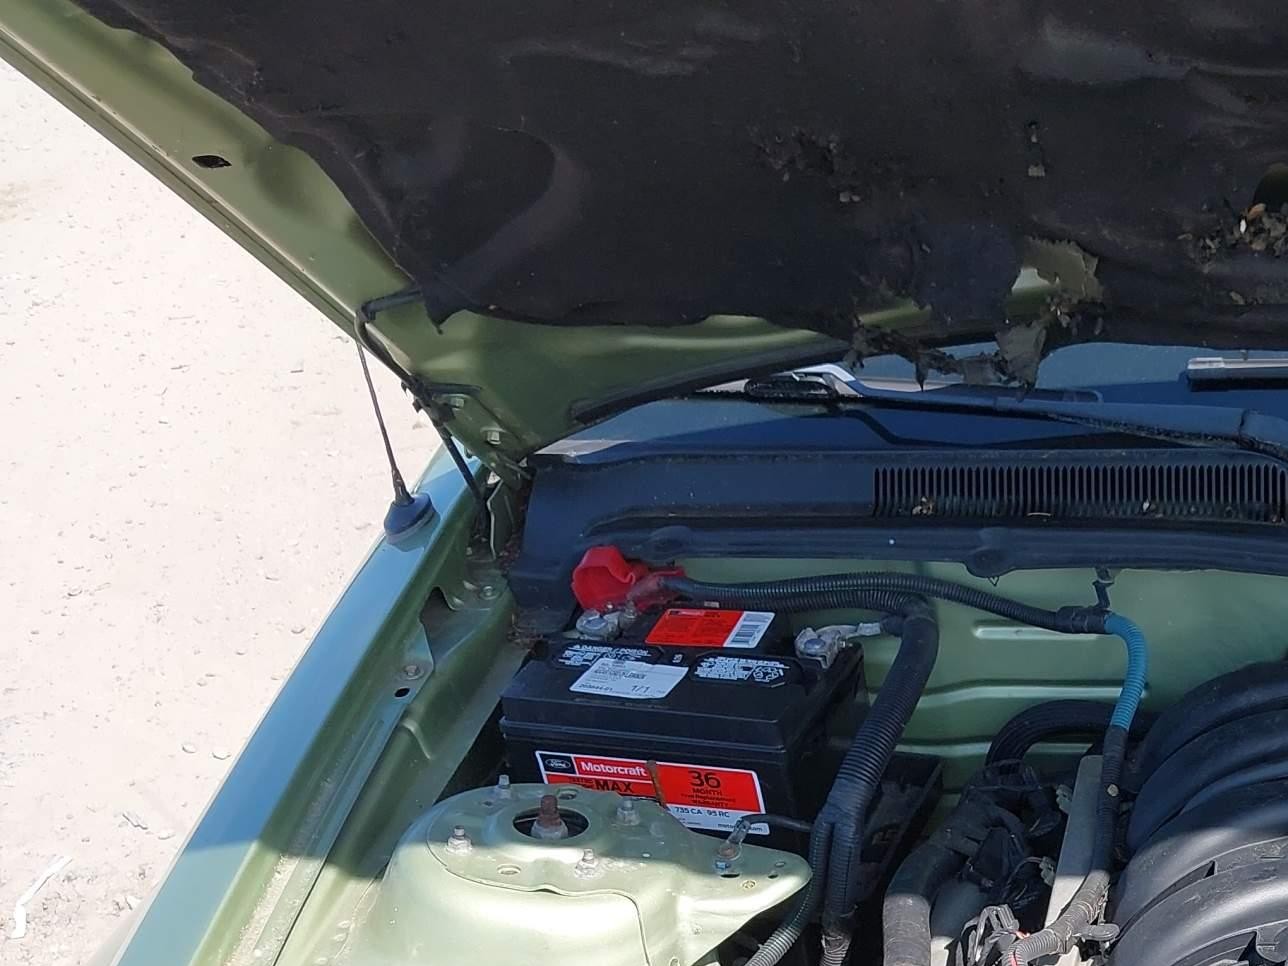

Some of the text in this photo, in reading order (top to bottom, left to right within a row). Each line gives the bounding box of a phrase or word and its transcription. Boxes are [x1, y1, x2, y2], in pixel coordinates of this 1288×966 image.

[580, 761, 648, 777] Motorcraft
[595, 779, 635, 794] MAX
[688, 771, 721, 789] 36
[691, 788, 723, 797] MONTH
[675, 806, 690, 815] 735
[690, 808, 703, 816] CA
[718, 810, 730, 818] RC
